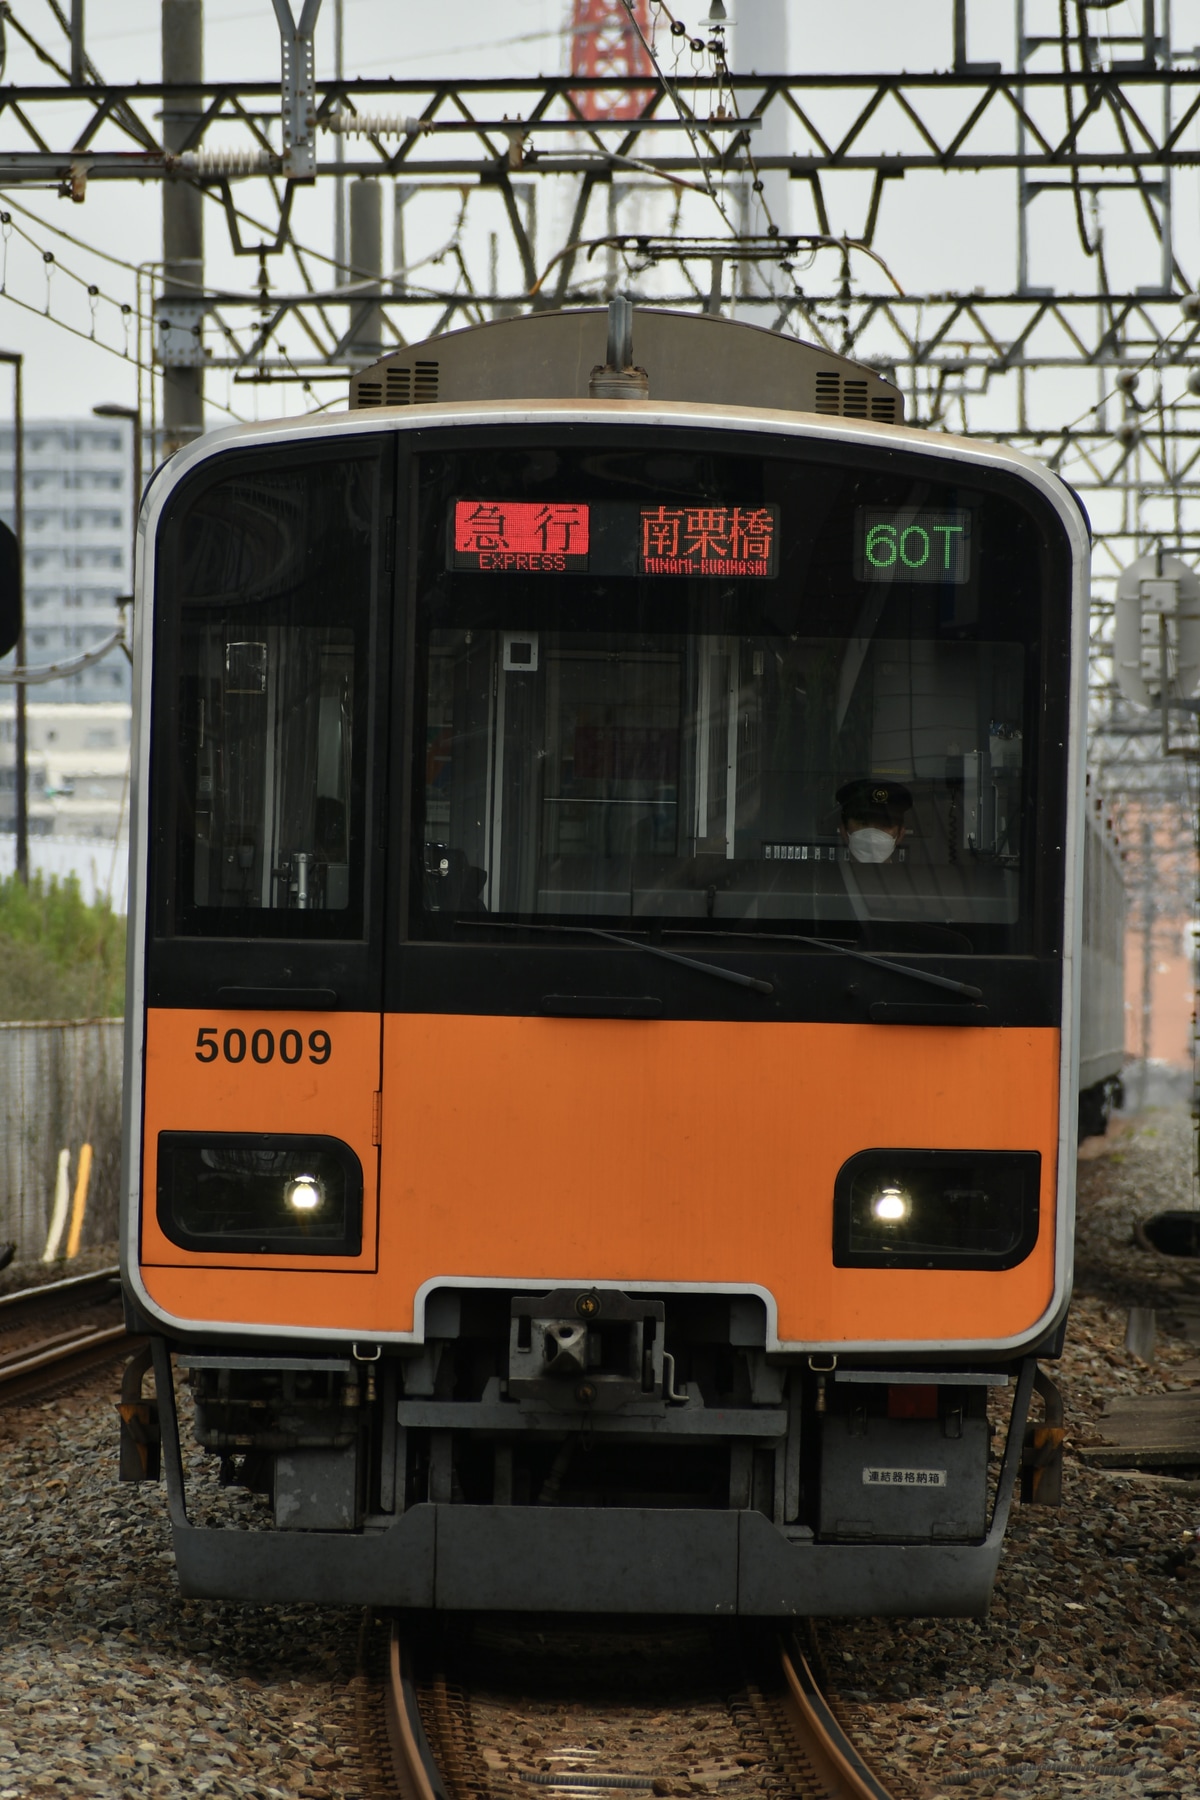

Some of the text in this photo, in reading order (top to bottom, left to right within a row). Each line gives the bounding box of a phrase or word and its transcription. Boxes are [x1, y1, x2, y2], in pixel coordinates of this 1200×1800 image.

[464, 504, 580, 552] 急行
[640, 505, 773, 559] 南栗橋
[865, 524, 963, 569] 60T
[479, 553, 566, 571] EXPRESS
[644, 557, 767, 575] MINAMI-KURIHASHI
[195, 1027, 332, 1065] 50009
[868, 1471, 940, 1484] 連結器格納箱
